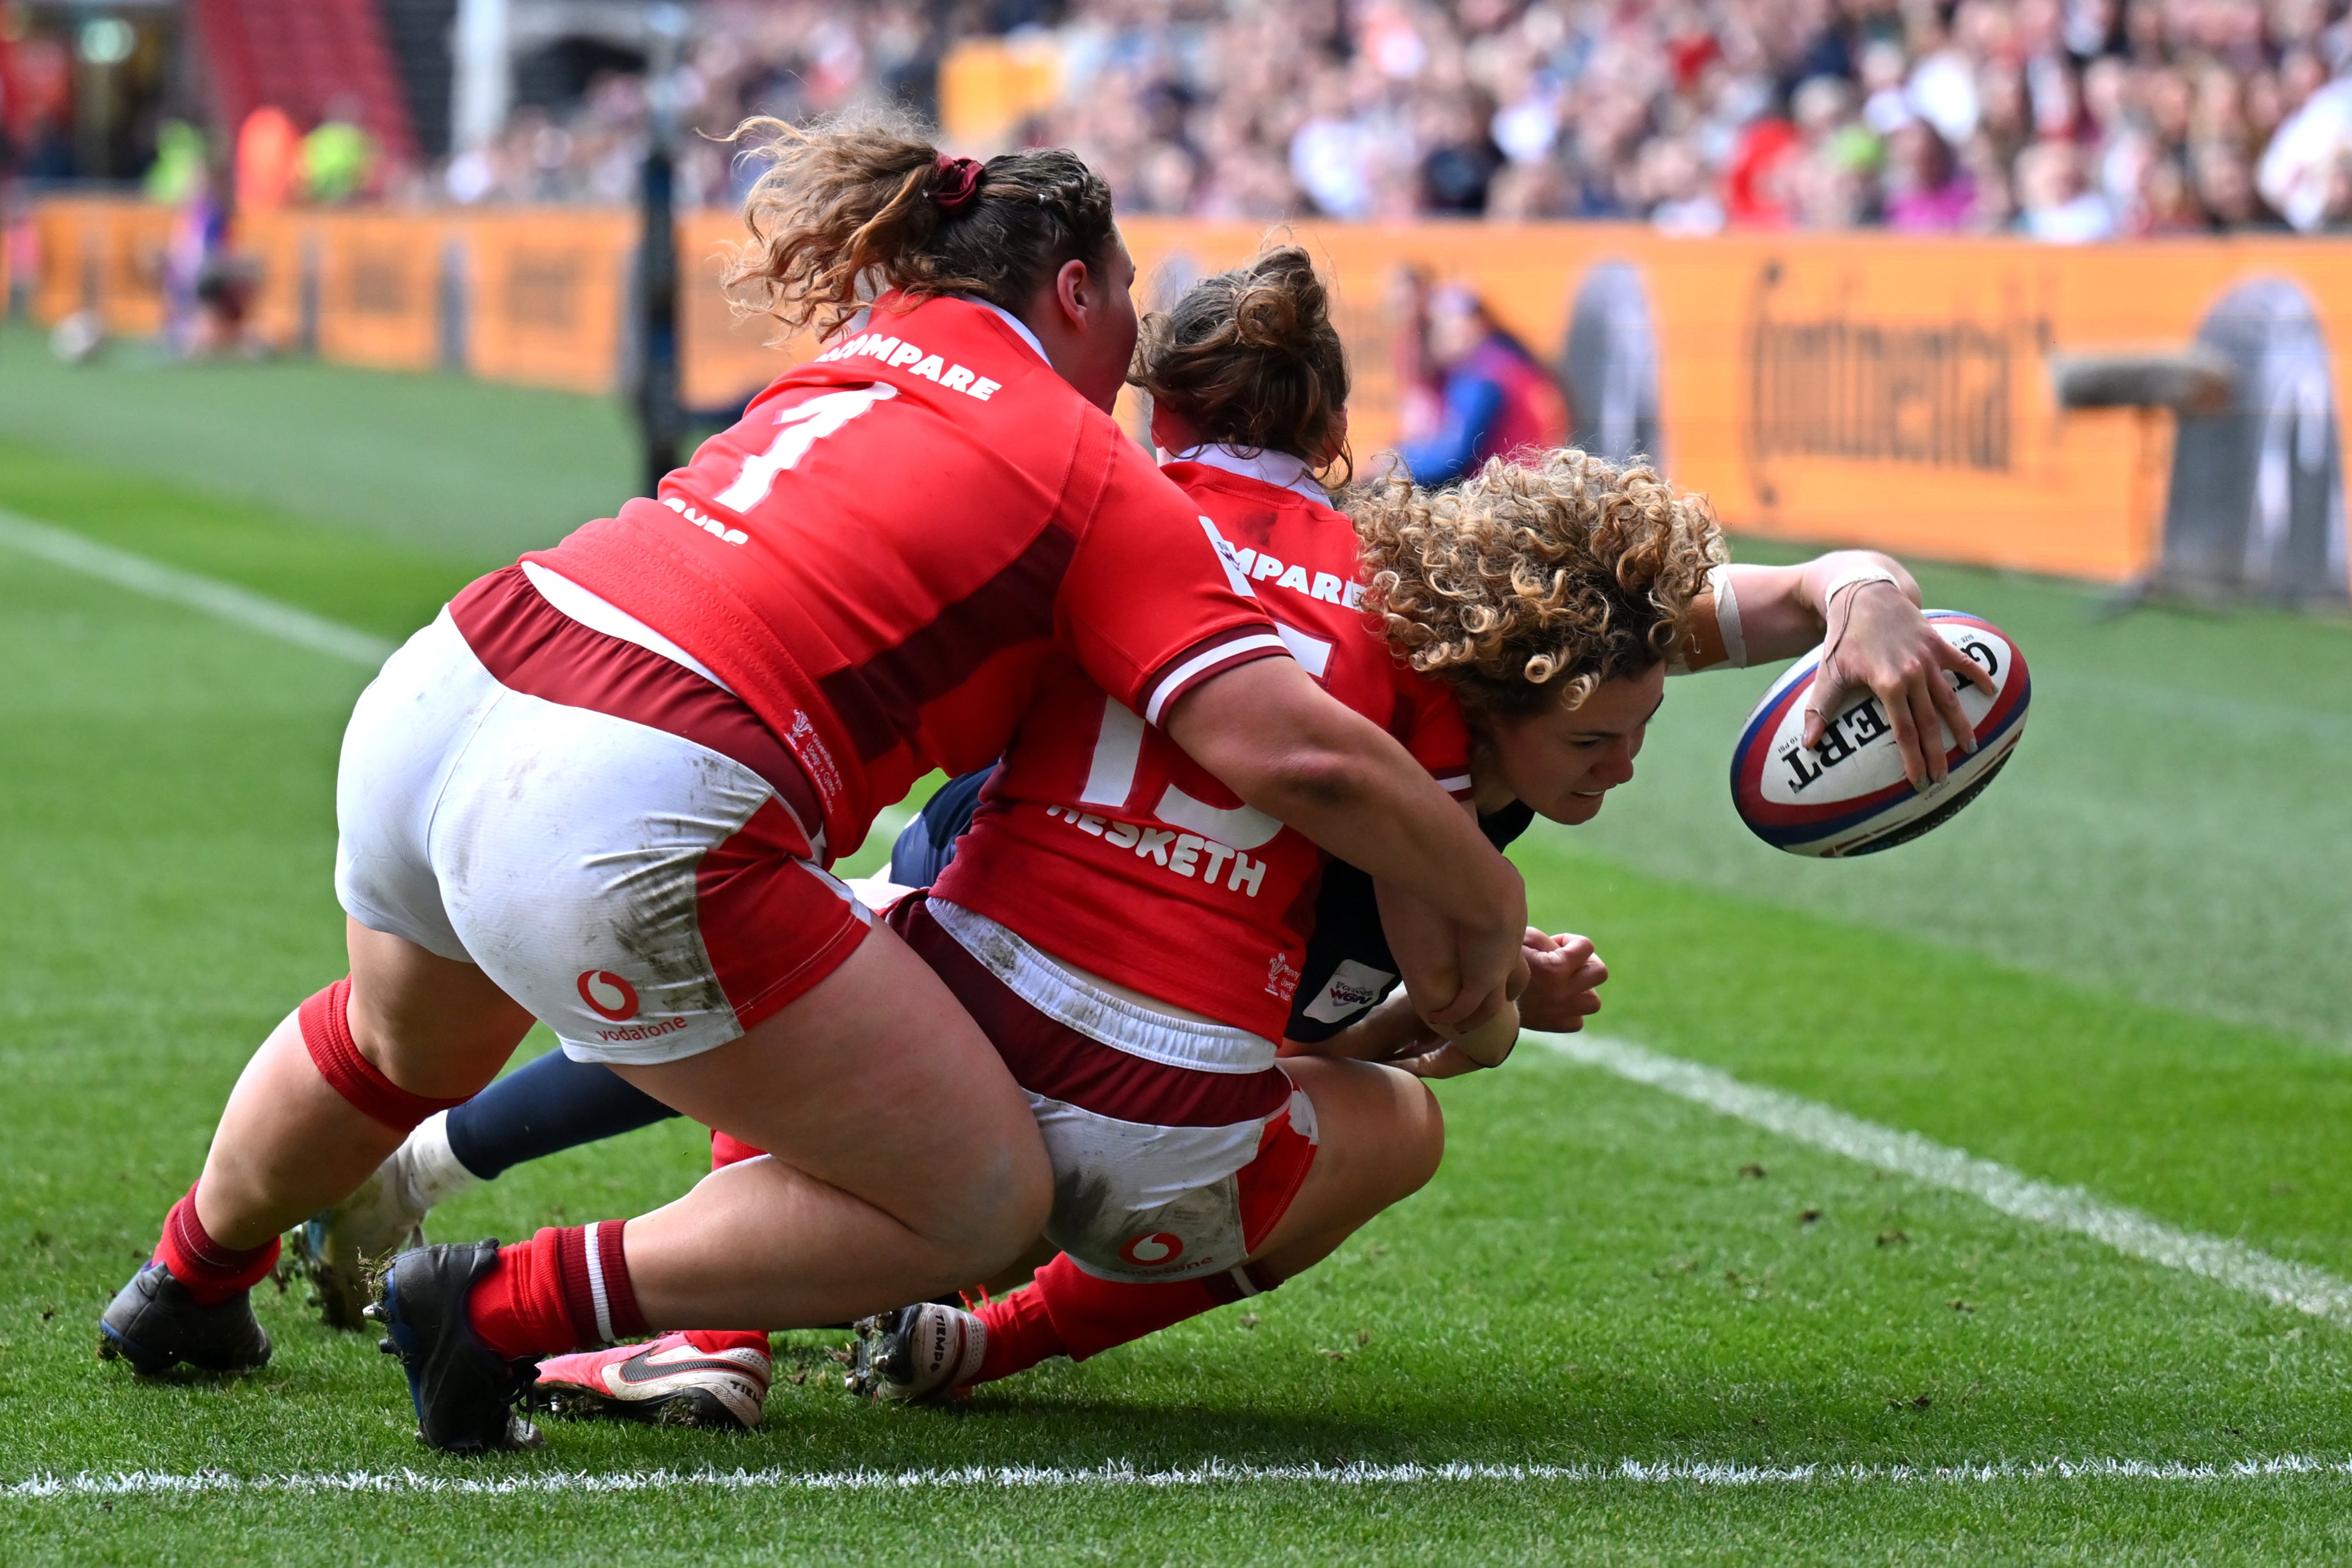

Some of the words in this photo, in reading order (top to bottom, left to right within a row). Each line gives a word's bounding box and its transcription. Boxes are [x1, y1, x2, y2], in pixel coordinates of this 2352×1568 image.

[711, 381, 898, 514] 1
[1223, 540, 1369, 612] MPARE
[1781, 641, 1998, 795] GERT
[596, 1017, 688, 1041] vodafone
[729, 1380, 762, 1411] TIEM
